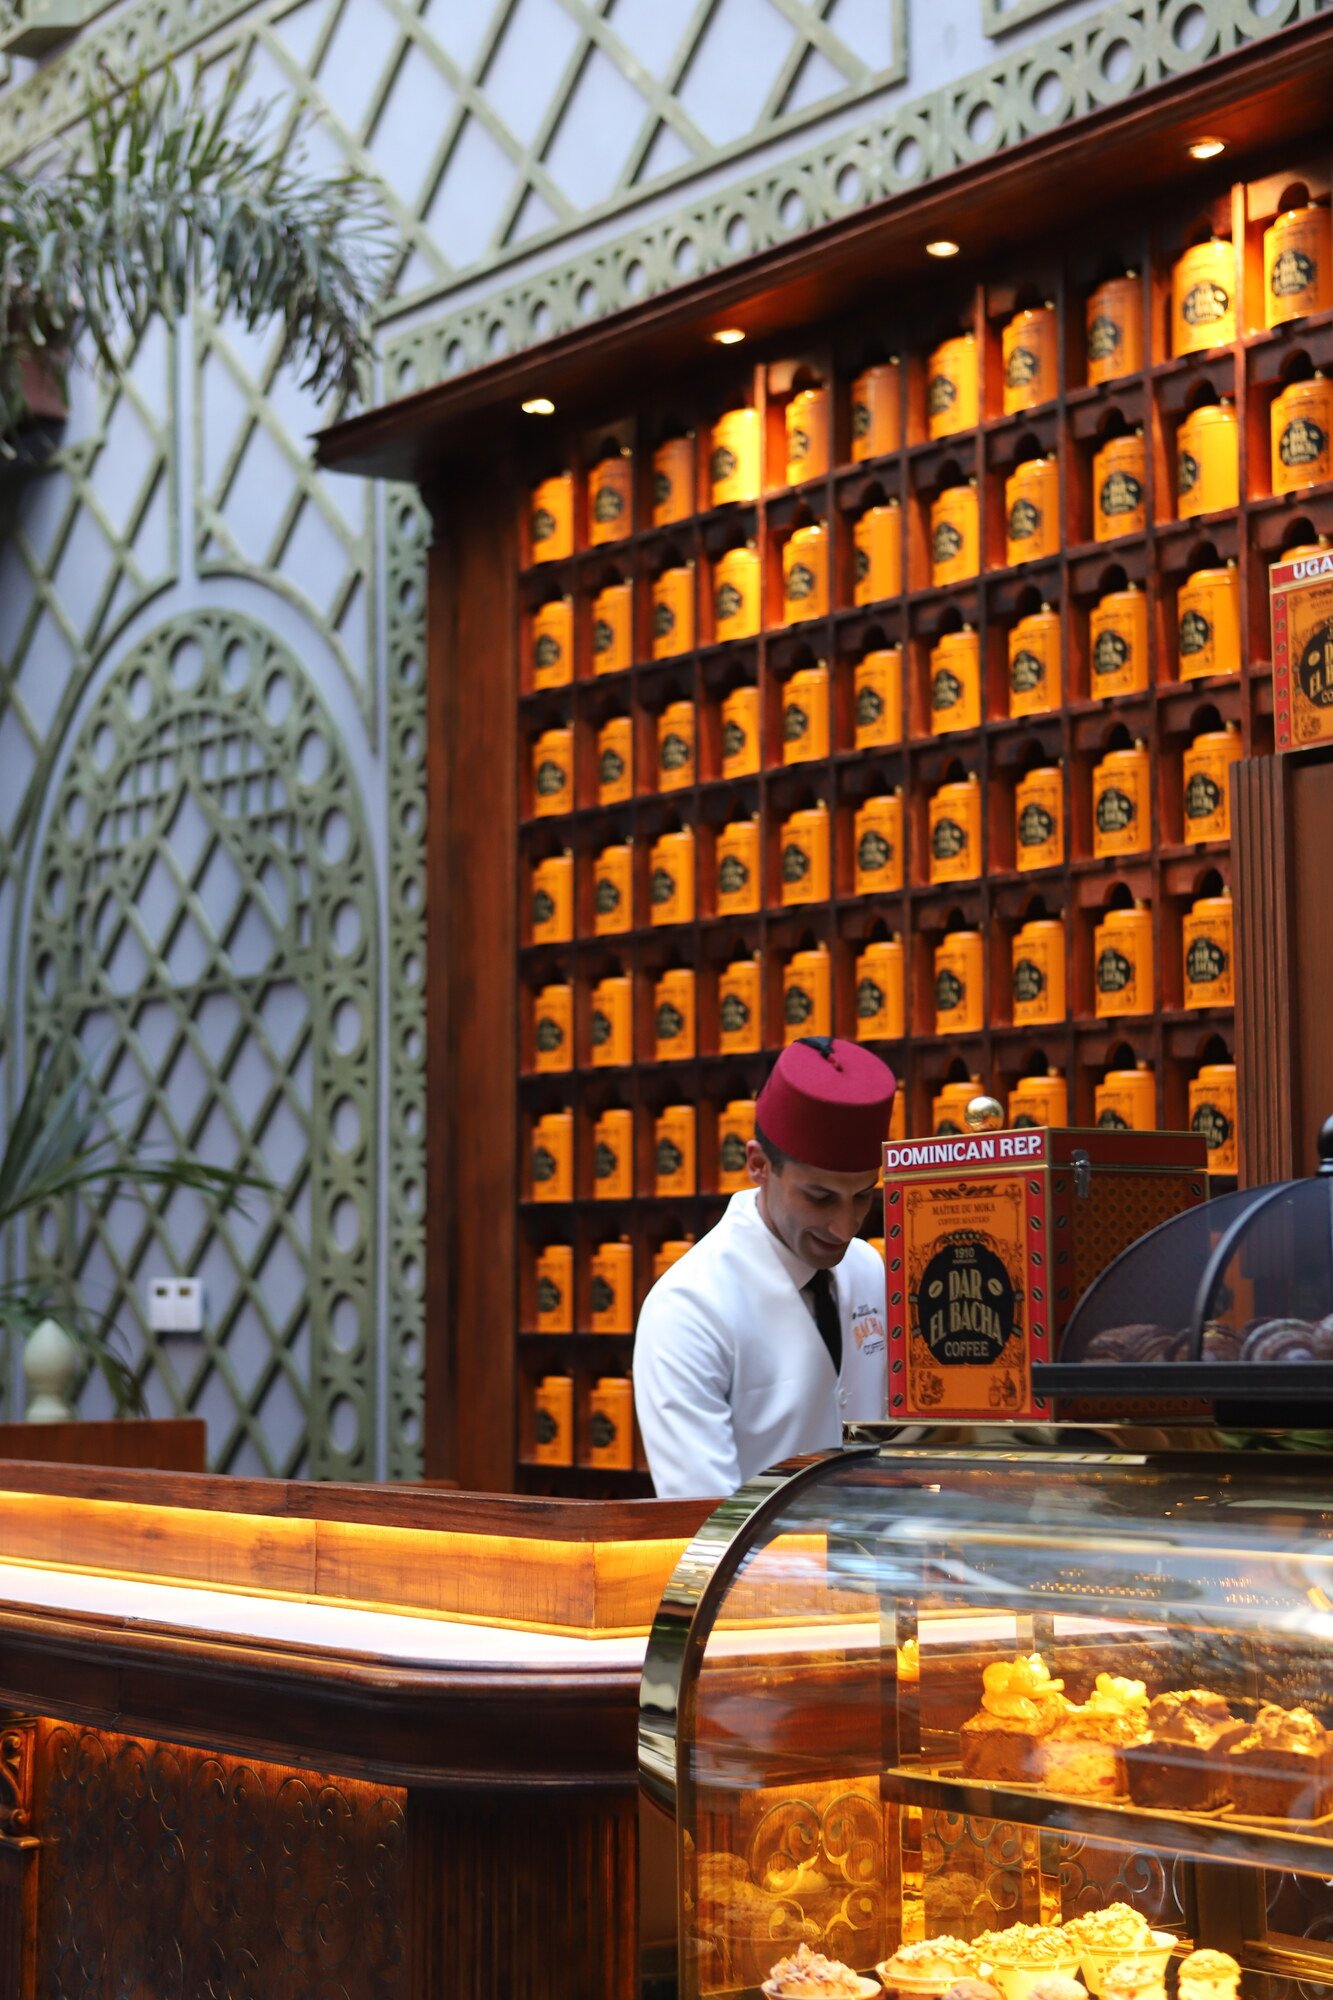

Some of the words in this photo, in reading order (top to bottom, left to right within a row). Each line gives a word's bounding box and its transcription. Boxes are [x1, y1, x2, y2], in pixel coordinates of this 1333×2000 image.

[887, 1139, 995, 1167] DOMINICAN
[1000, 1135, 1042, 1157] REP.
[954, 1247, 975, 1258] 1910
[949, 1268, 983, 1301] DAR
[930, 1309, 947, 1347] EL
[950, 1300, 1003, 1347] BACHA
[944, 1341, 989, 1357] COFFEE
